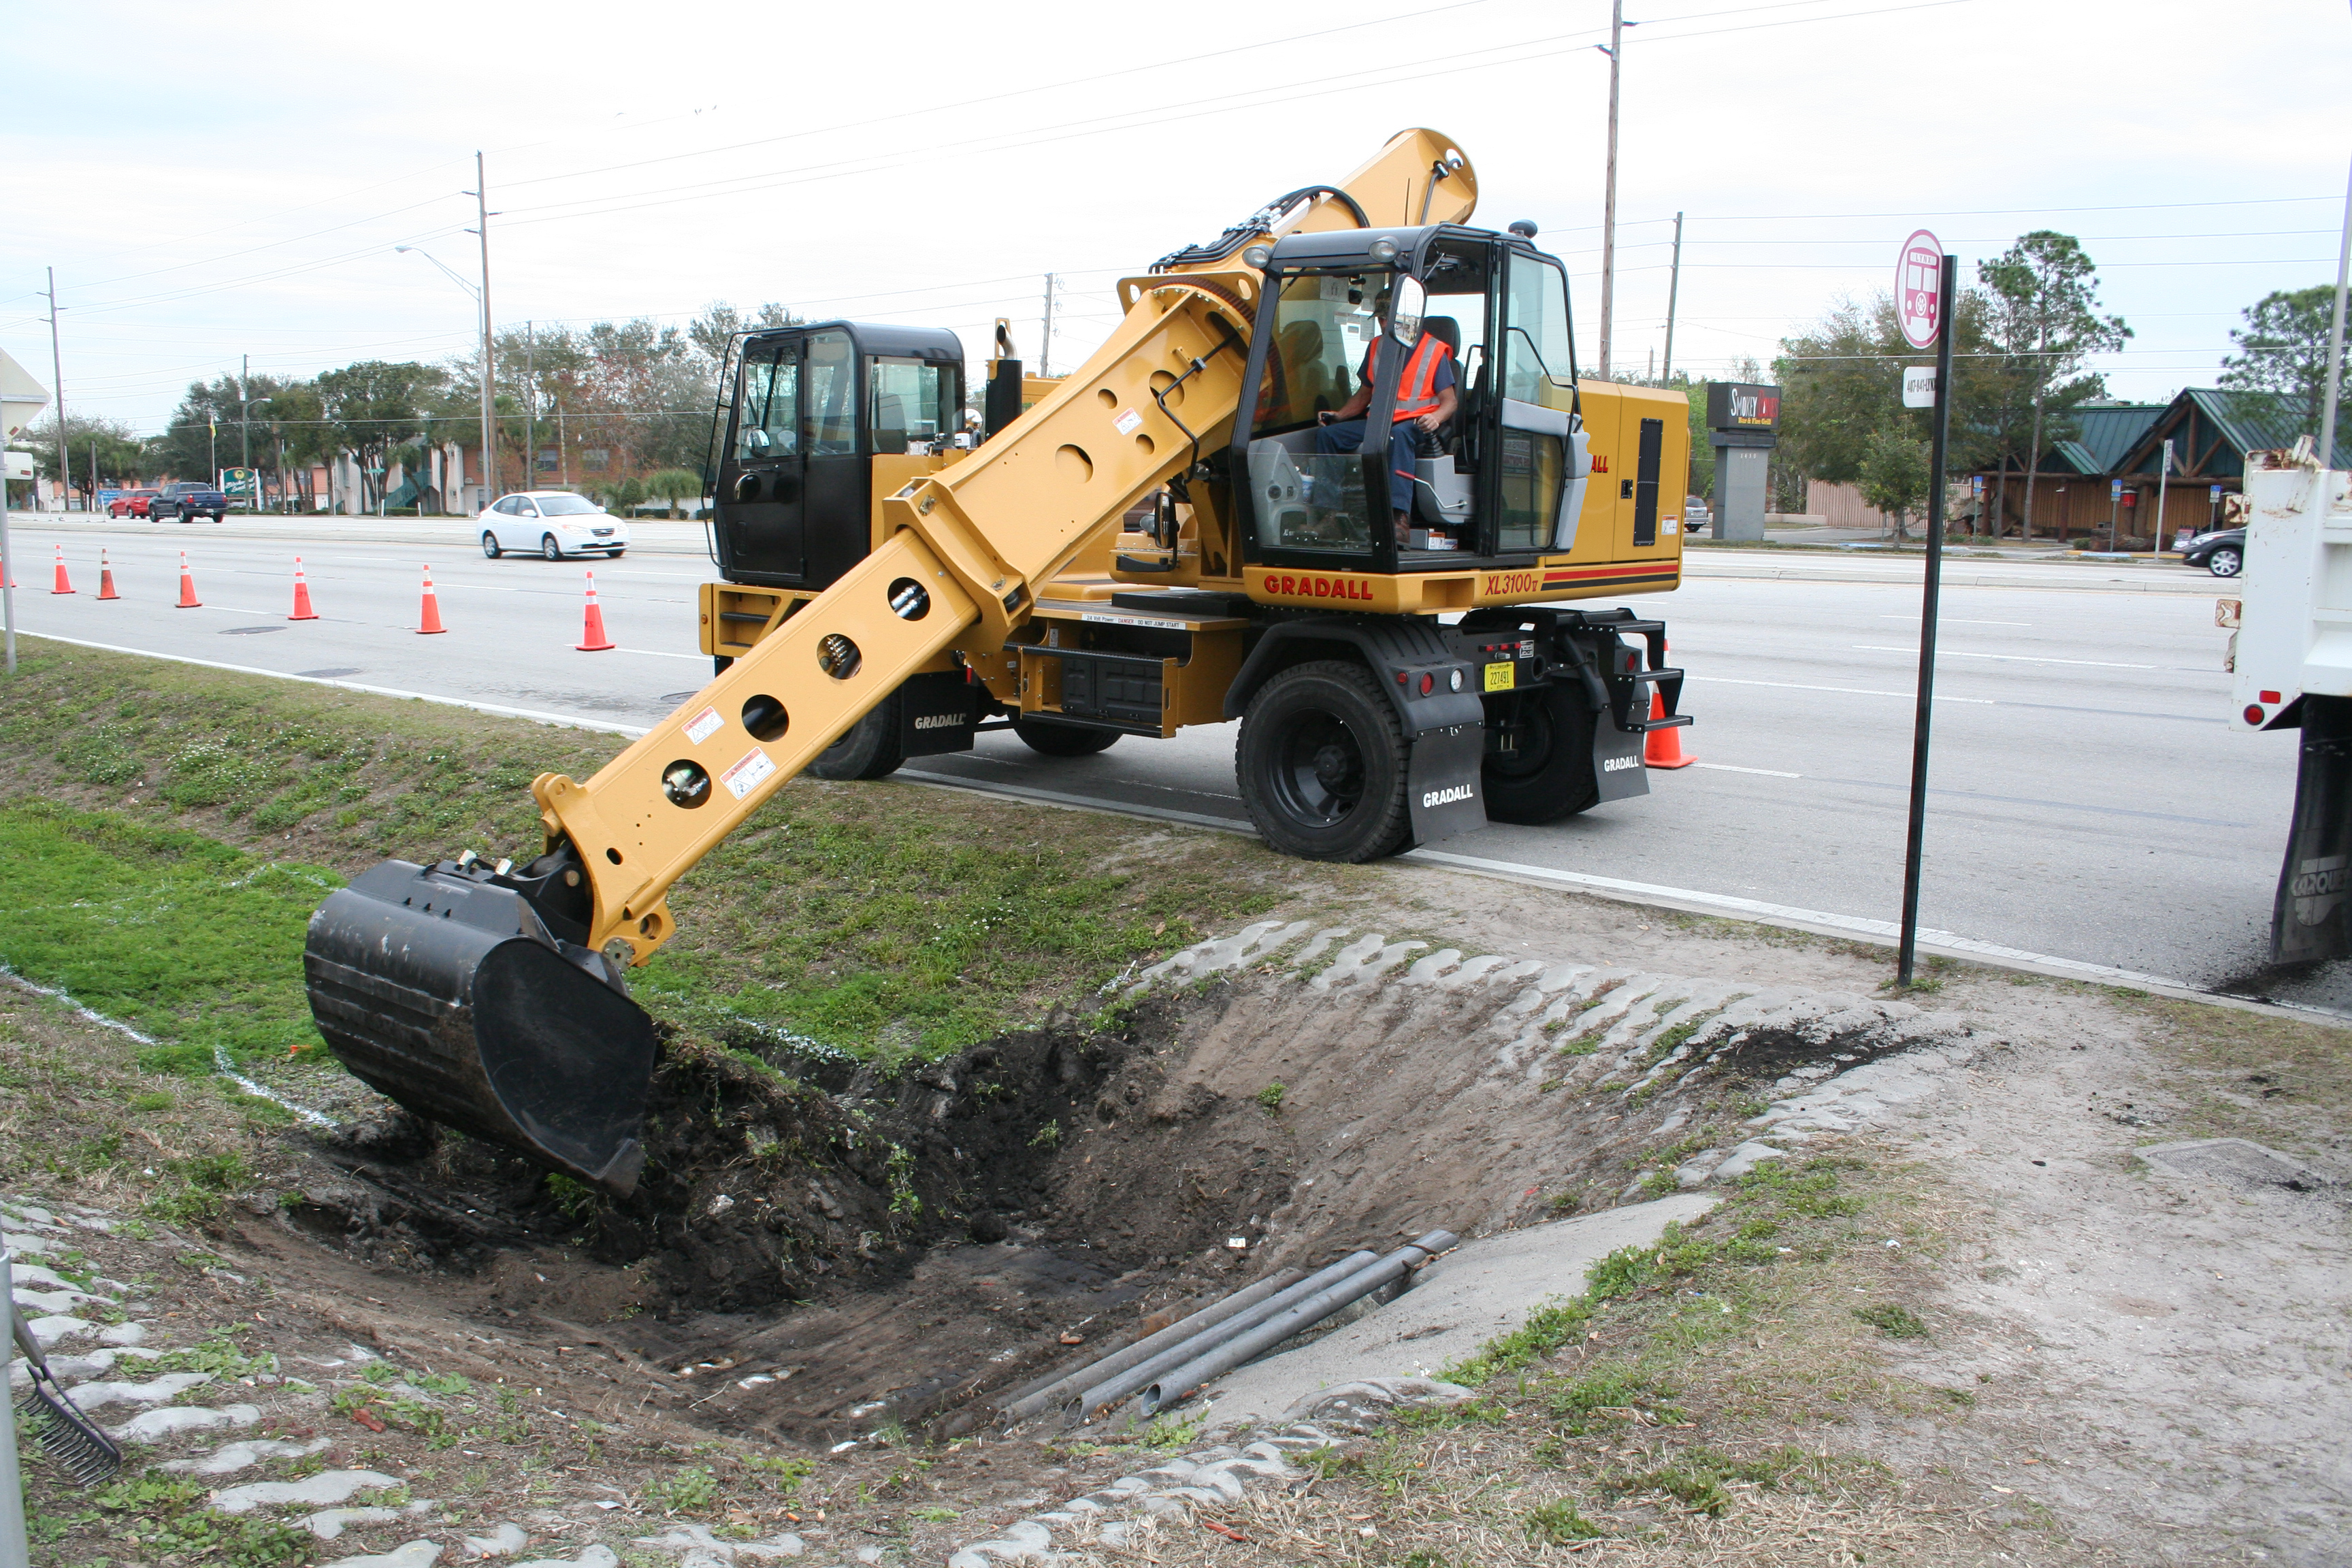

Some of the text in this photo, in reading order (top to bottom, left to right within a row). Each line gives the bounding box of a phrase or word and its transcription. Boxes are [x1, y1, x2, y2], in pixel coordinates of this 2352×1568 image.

[1916, 254, 1931, 263] LYNX
[1264, 575, 1373, 600] GRADALL
[915, 713, 964, 730] GRADALL
[1604, 755, 1639, 772] GRADALL
[1423, 784, 1473, 808] GRADALL
